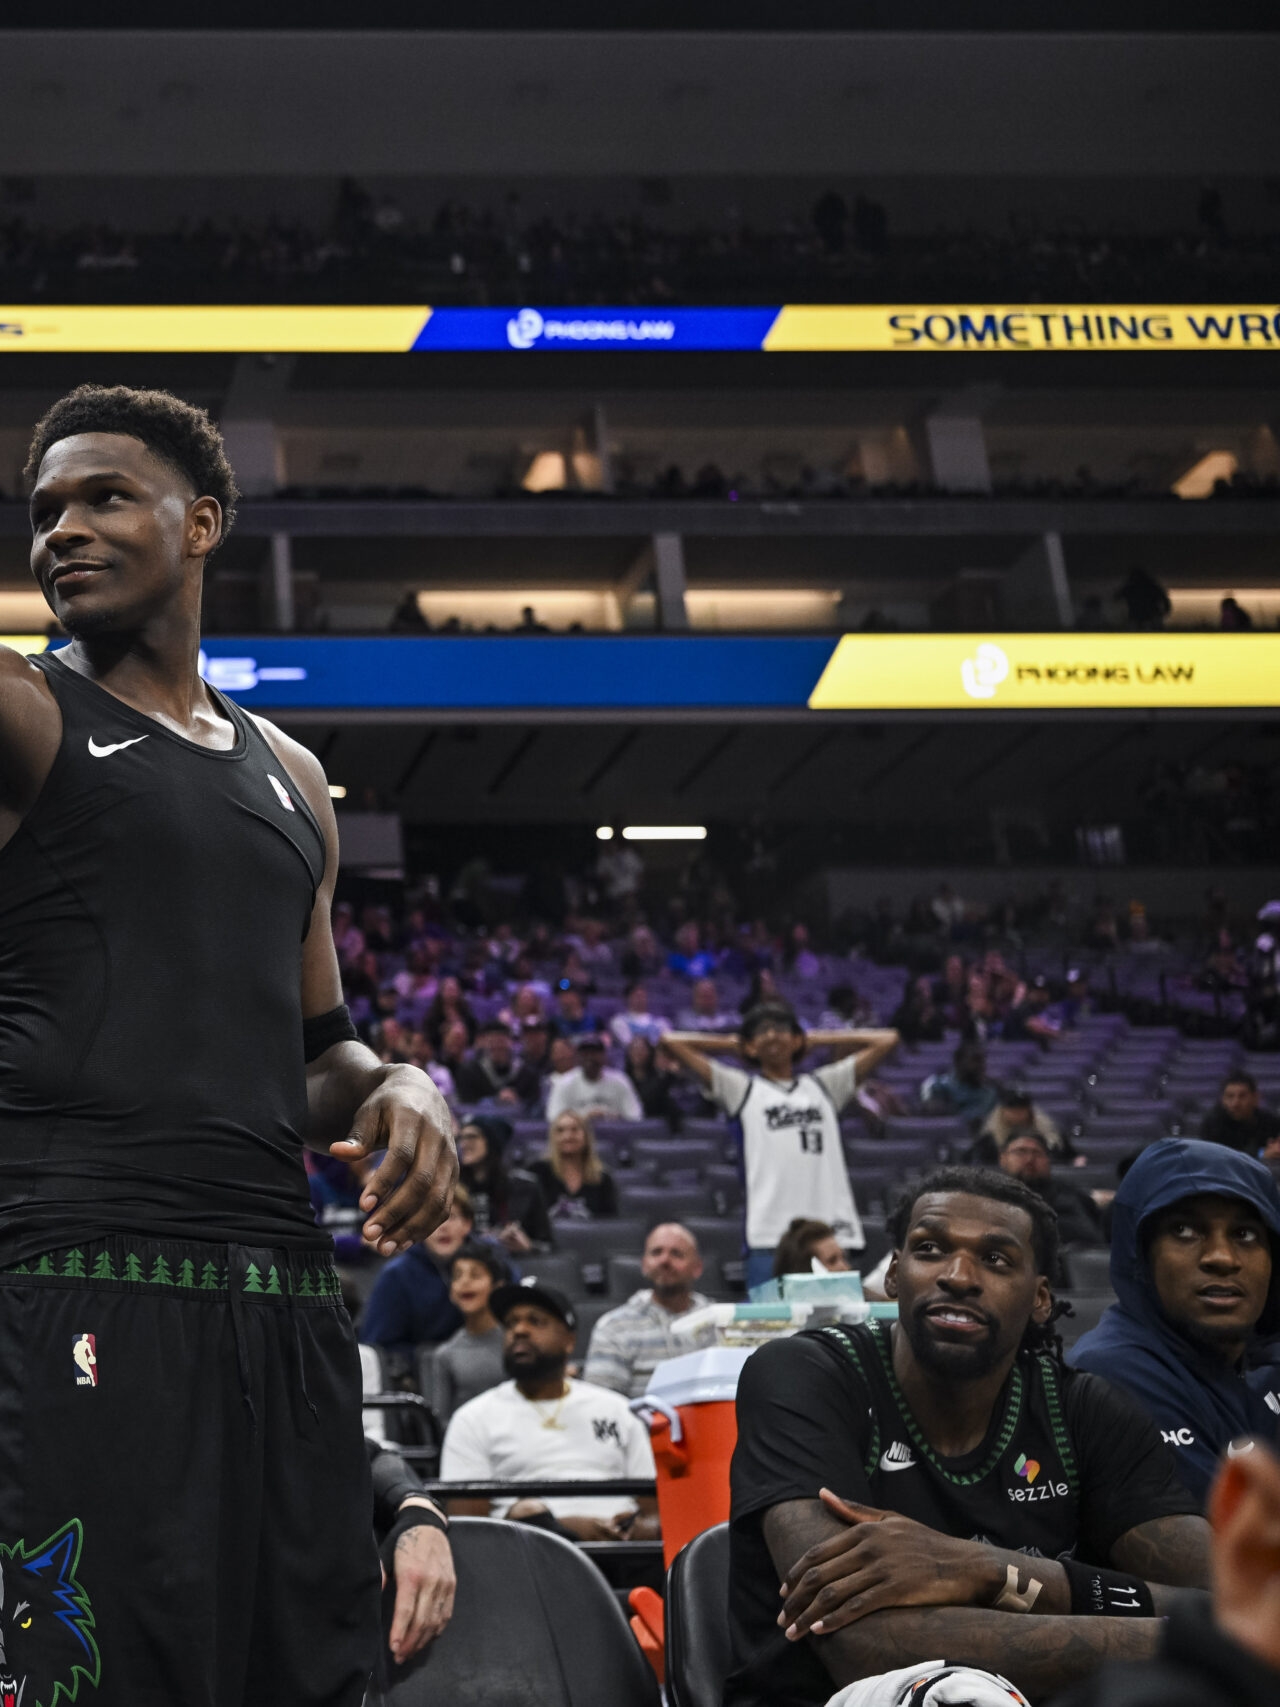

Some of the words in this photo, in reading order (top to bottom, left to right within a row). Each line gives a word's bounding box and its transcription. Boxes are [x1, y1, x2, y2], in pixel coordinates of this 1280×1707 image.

[627, 319, 675, 341] LAW
[888, 313, 1174, 347] SOMETHING
[1186, 314, 1280, 346] WR
[1136, 663, 1195, 685] LAW
[76, 1376, 92, 1386] NBA
[1007, 1479, 1069, 1502] sezzle
